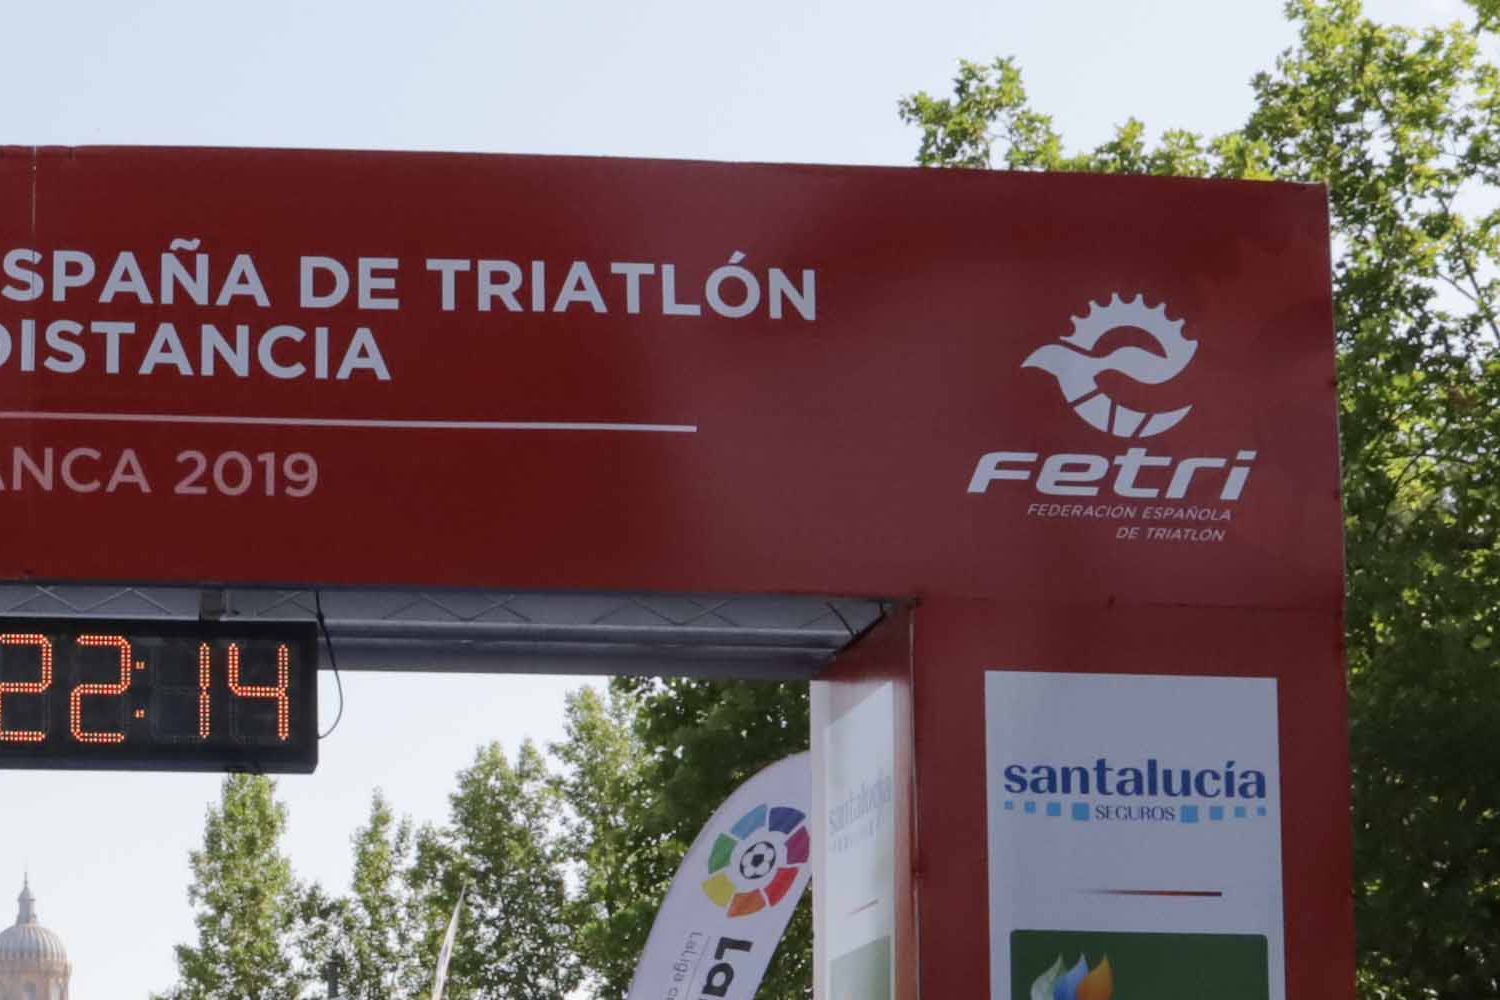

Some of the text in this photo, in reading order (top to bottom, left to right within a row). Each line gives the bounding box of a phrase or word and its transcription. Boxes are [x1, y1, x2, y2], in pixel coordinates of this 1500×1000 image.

[300, 256, 399, 310] DE
[426, 250, 816, 321] TRIATLÓN
[173, 451, 319, 498] 2019
[1027, 503, 1232, 521] FEDERACIÓN ESPAÑOLA
[1115, 524, 1226, 541] DE TRIATLÓN
[1003, 758, 1267, 800] santalucía
[1094, 805, 1176, 822] SEGUROS
